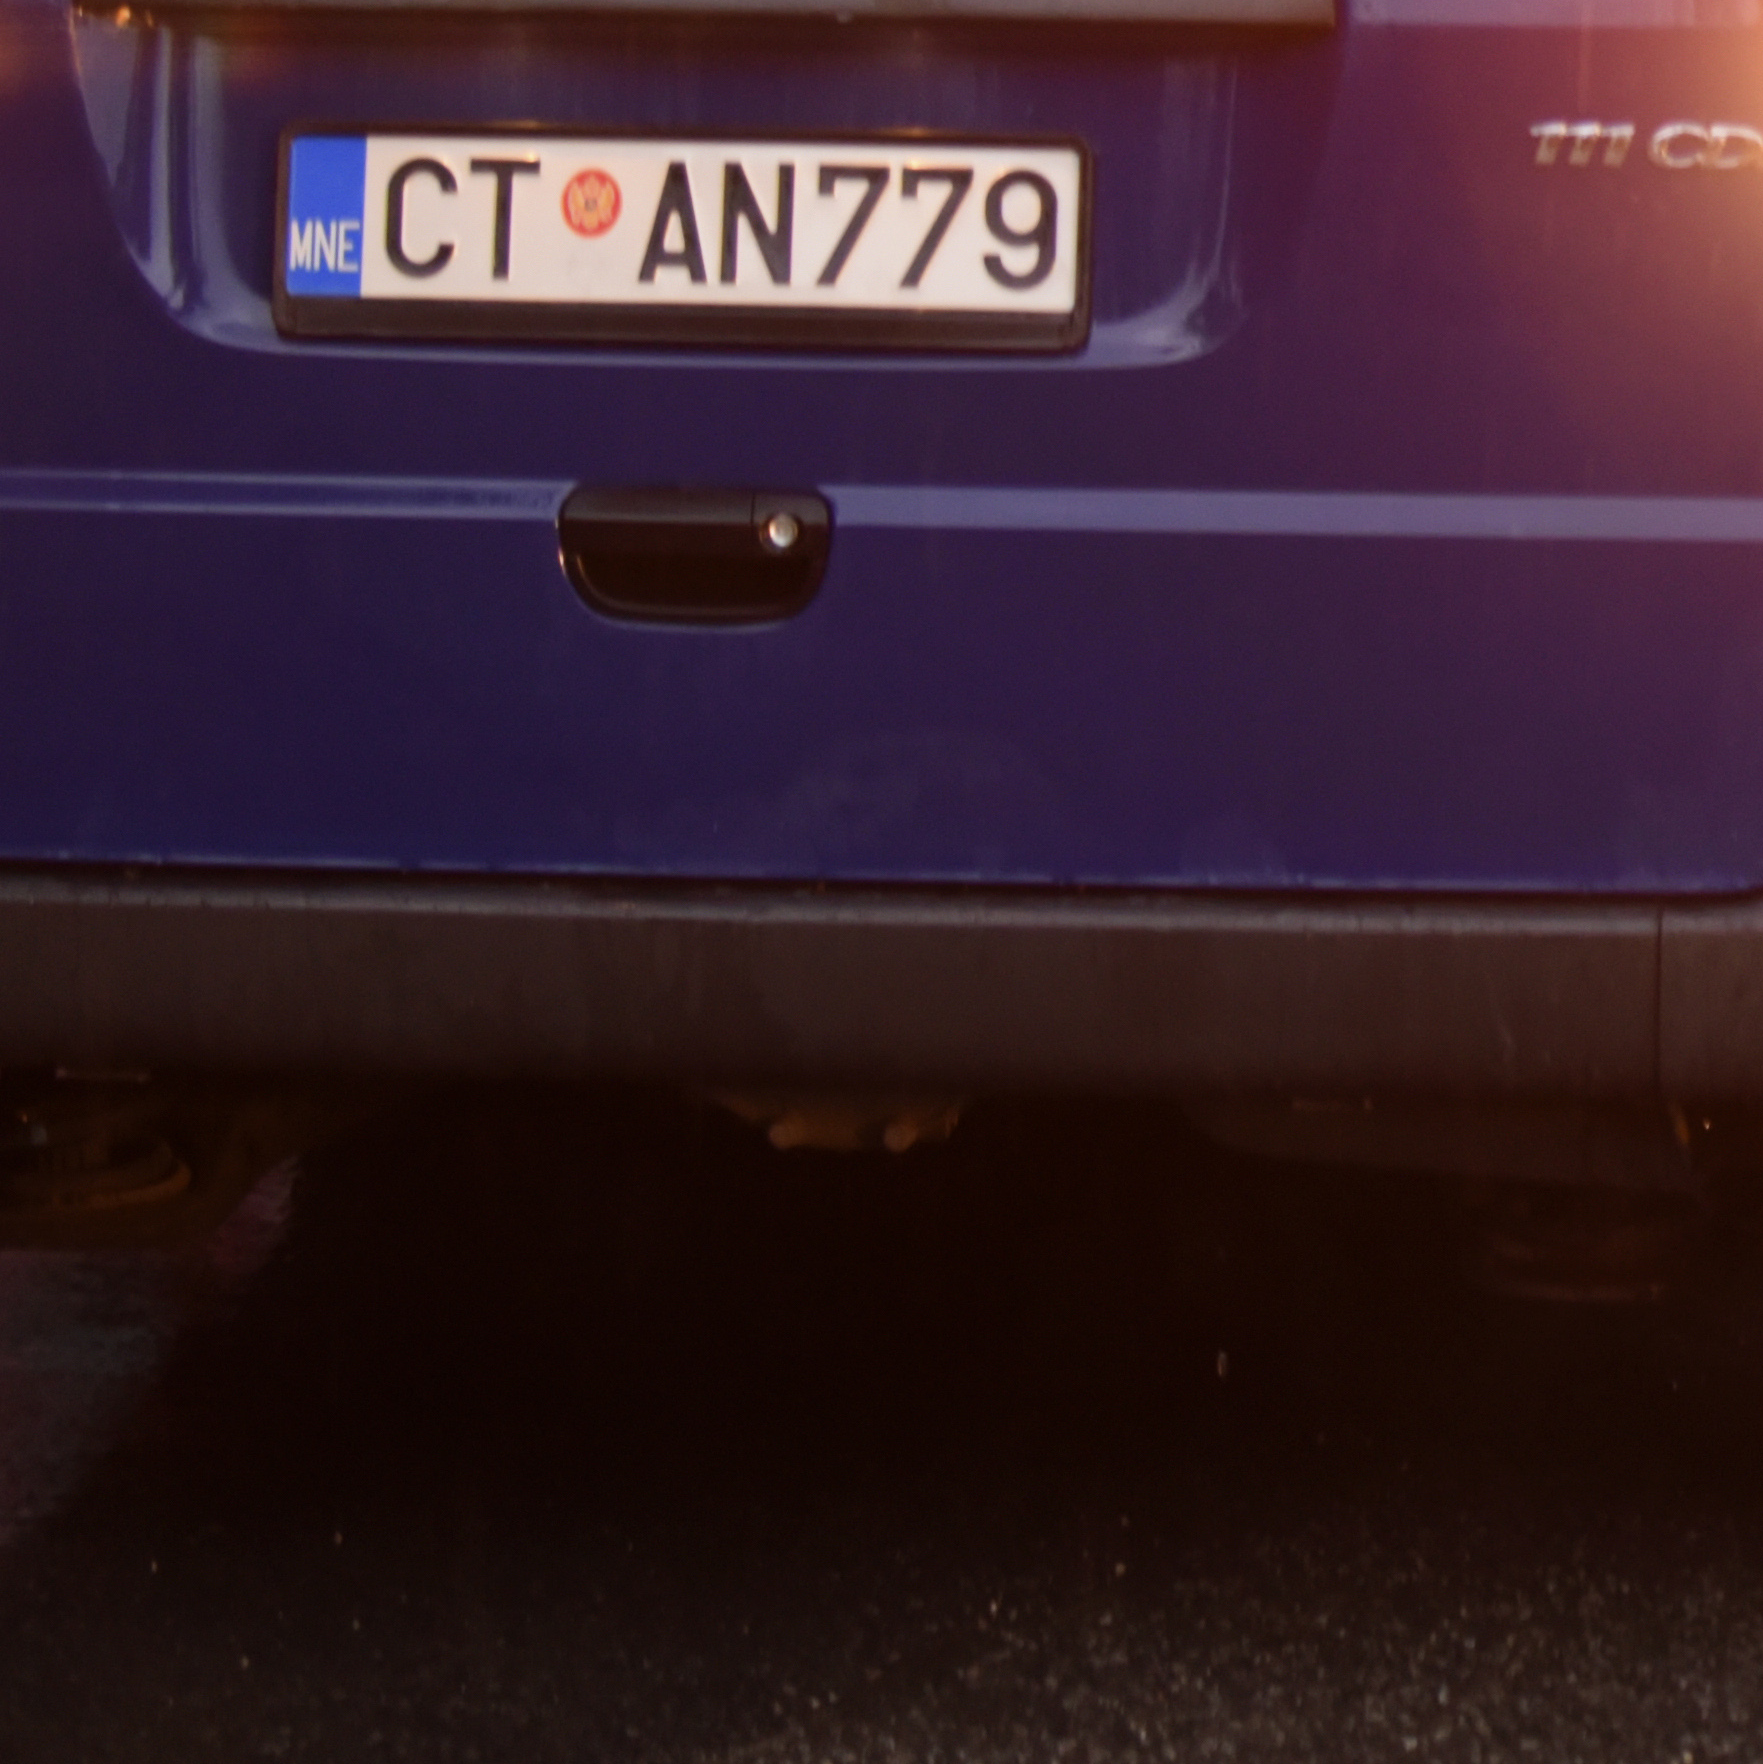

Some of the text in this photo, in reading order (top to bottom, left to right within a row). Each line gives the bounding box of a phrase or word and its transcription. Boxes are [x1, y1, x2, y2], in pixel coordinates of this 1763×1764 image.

[289, 156, 1059, 290] MNE CT AN779
